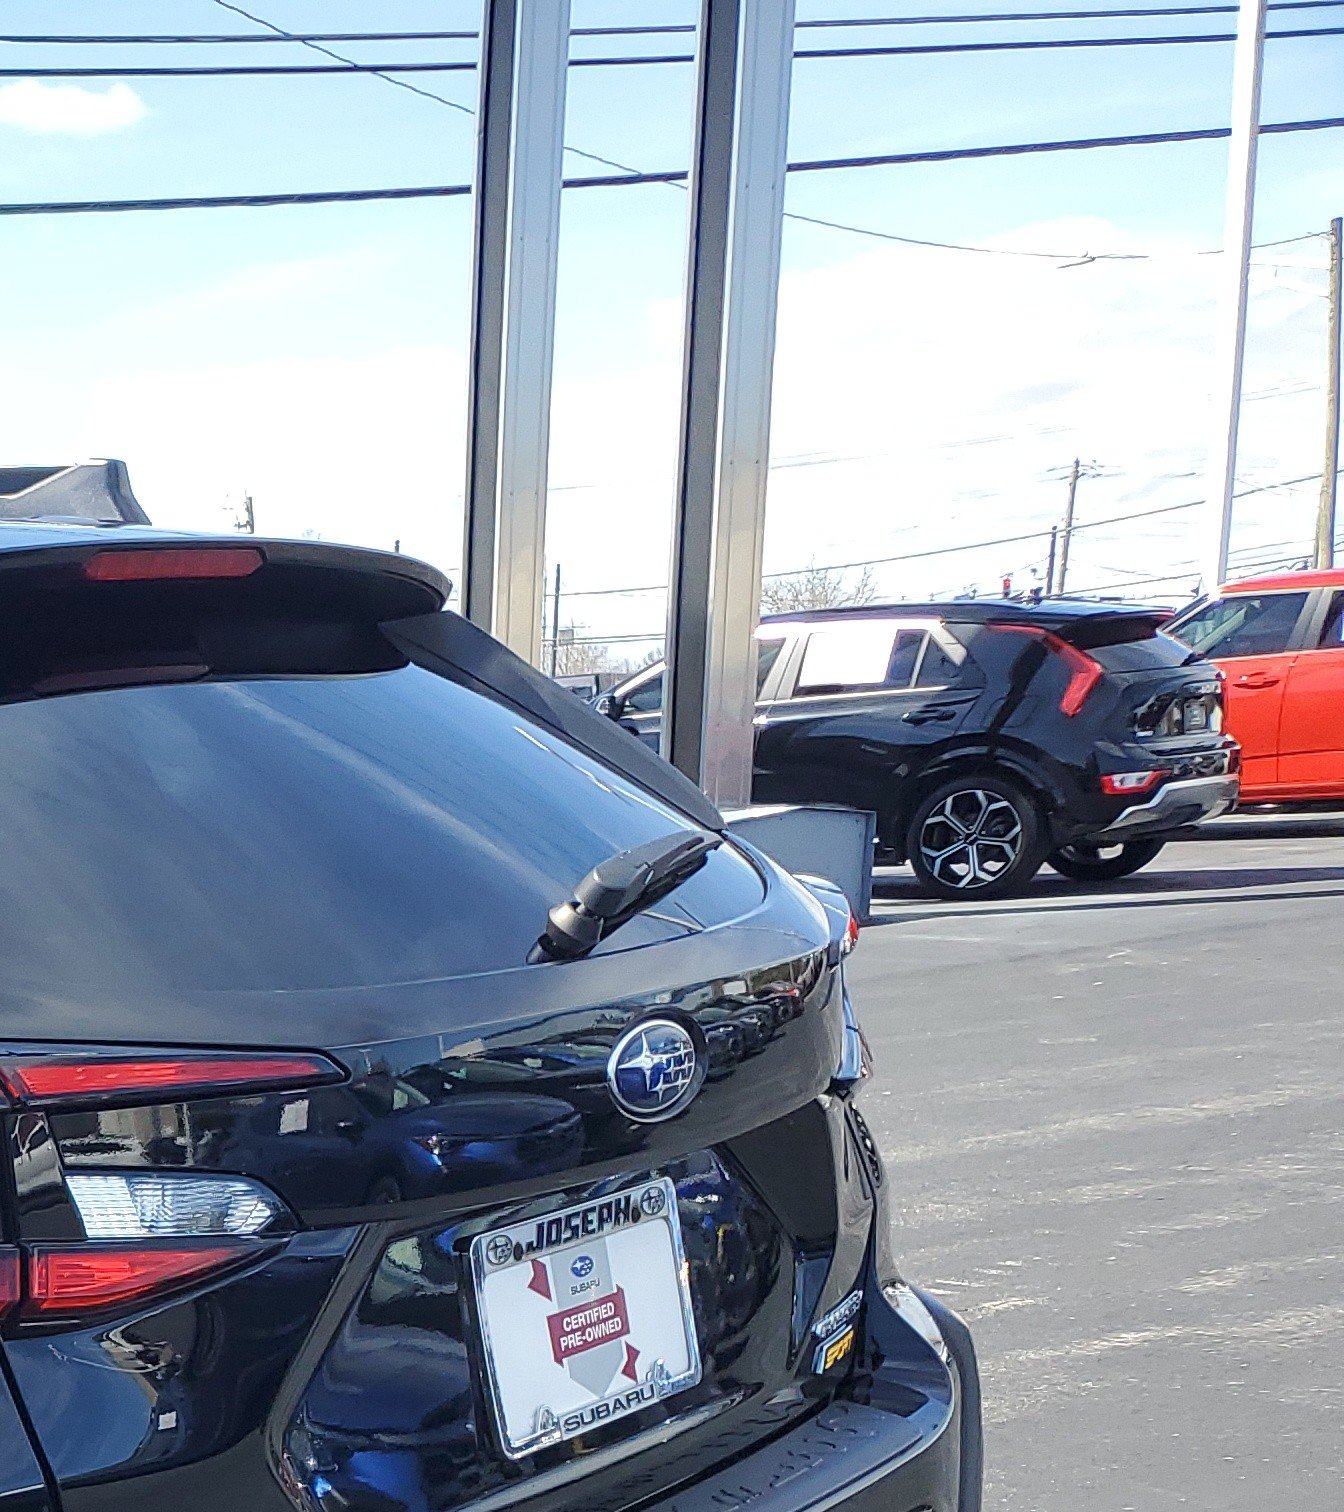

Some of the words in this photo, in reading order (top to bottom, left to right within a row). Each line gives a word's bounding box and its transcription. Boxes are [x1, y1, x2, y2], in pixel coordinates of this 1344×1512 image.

[525, 1194, 632, 1253] JOSEPH
[570, 1277, 600, 1296] SUBARU
[562, 1301, 615, 1332] CERTIFIED
[559, 1317, 622, 1351] PRE-OWNED
[563, 1383, 655, 1433] SUBARU
